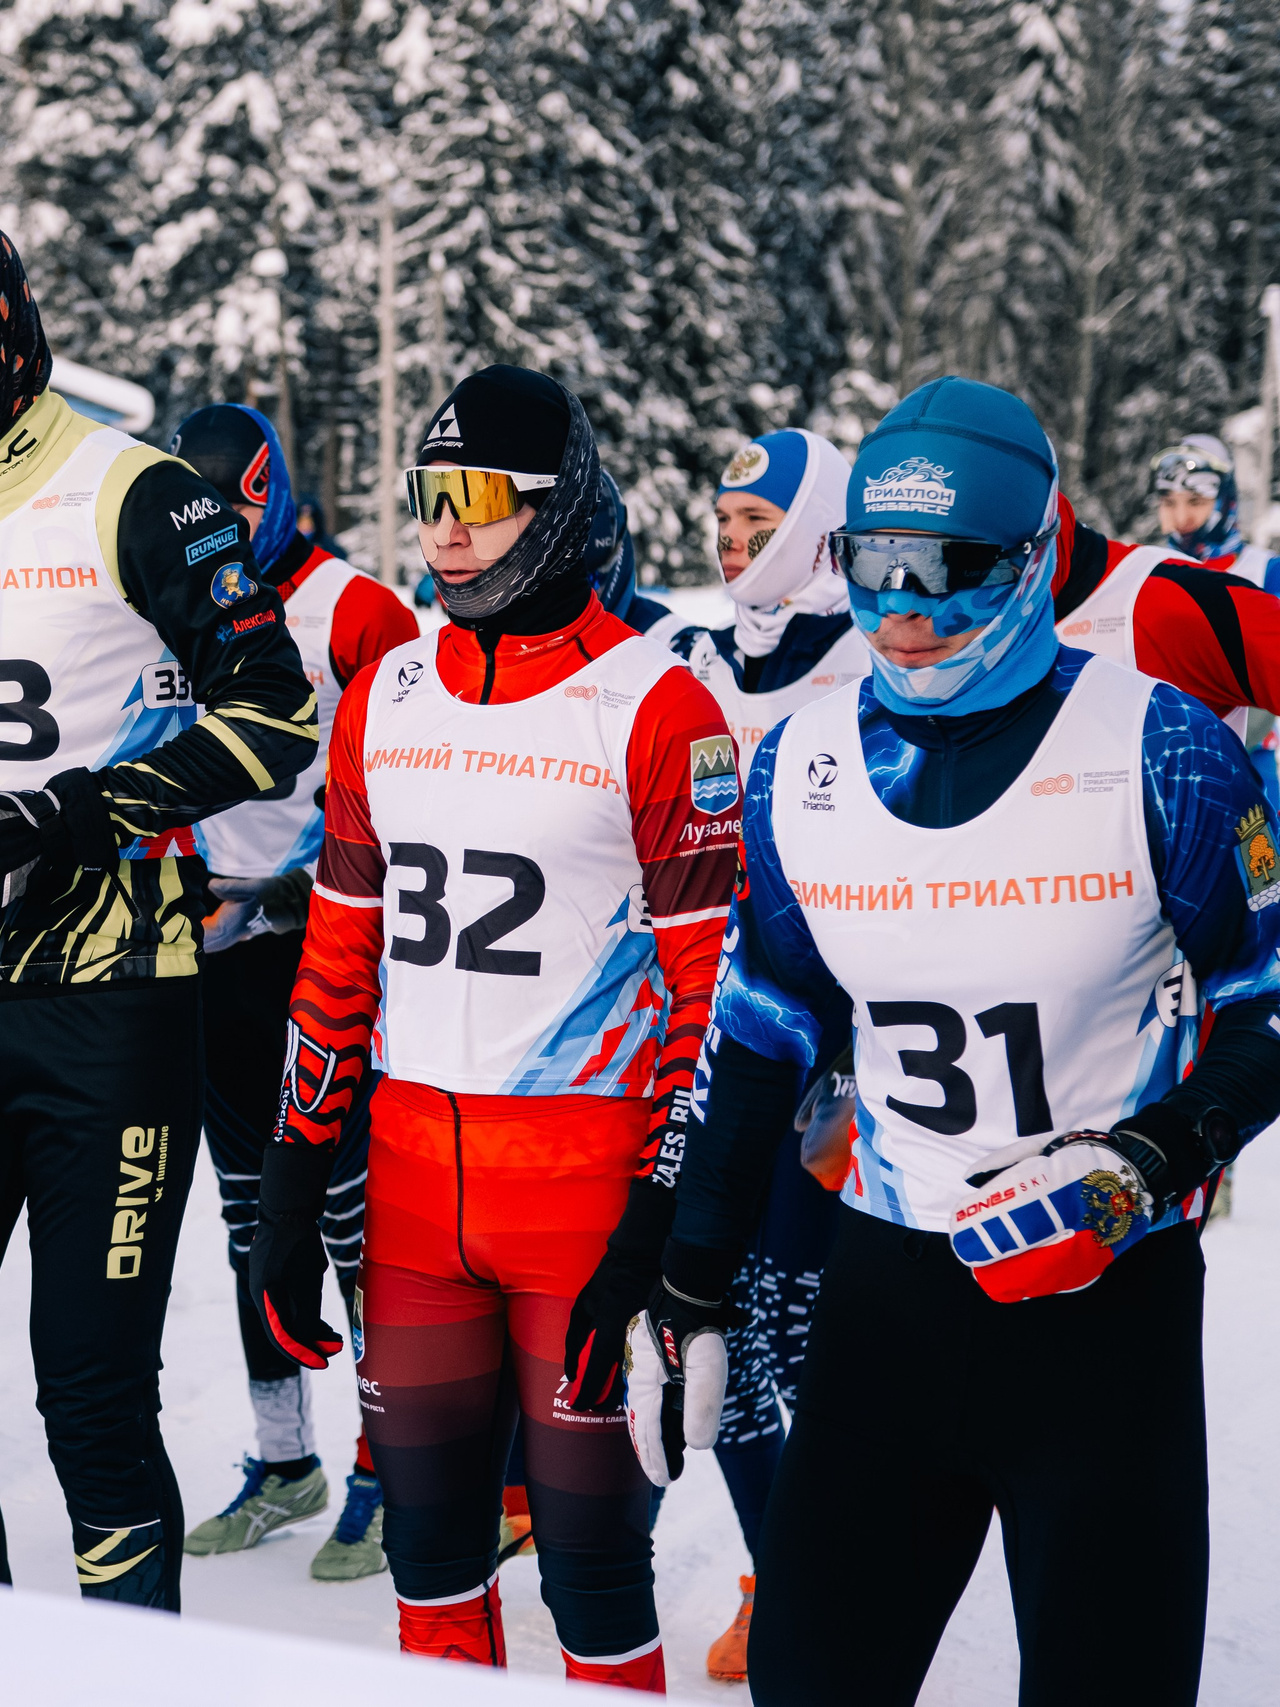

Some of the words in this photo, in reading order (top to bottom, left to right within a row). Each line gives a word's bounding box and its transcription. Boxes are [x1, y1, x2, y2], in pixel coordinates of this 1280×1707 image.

[865, 501, 950, 516] КУЗБАСС
[866, 487, 952, 503] ТРИАТЛОН
[190, 530, 235, 560] RUNHUB
[154, 668, 192, 702] 33
[365, 742, 452, 775] ИМНИЙ
[462, 749, 621, 795] ТРИАТЛОН
[802, 800, 836, 812] Triathlon
[808, 791, 832, 801] World
[679, 819, 742, 845] Лузале
[789, 875, 914, 911] ЗИМНИЙ
[925, 869, 1134, 910] ТРИАТЛОН
[388, 841, 547, 977] 32
[866, 1000, 1055, 1138] 31
[955, 1187, 1017, 1223] BONES
[1019, 1173, 1048, 1192] SKI
[552, 1411, 605, 1424] ПРОДОЛЖЕНИЕ
[605, 1415, 628, 1424] СЛАВН
